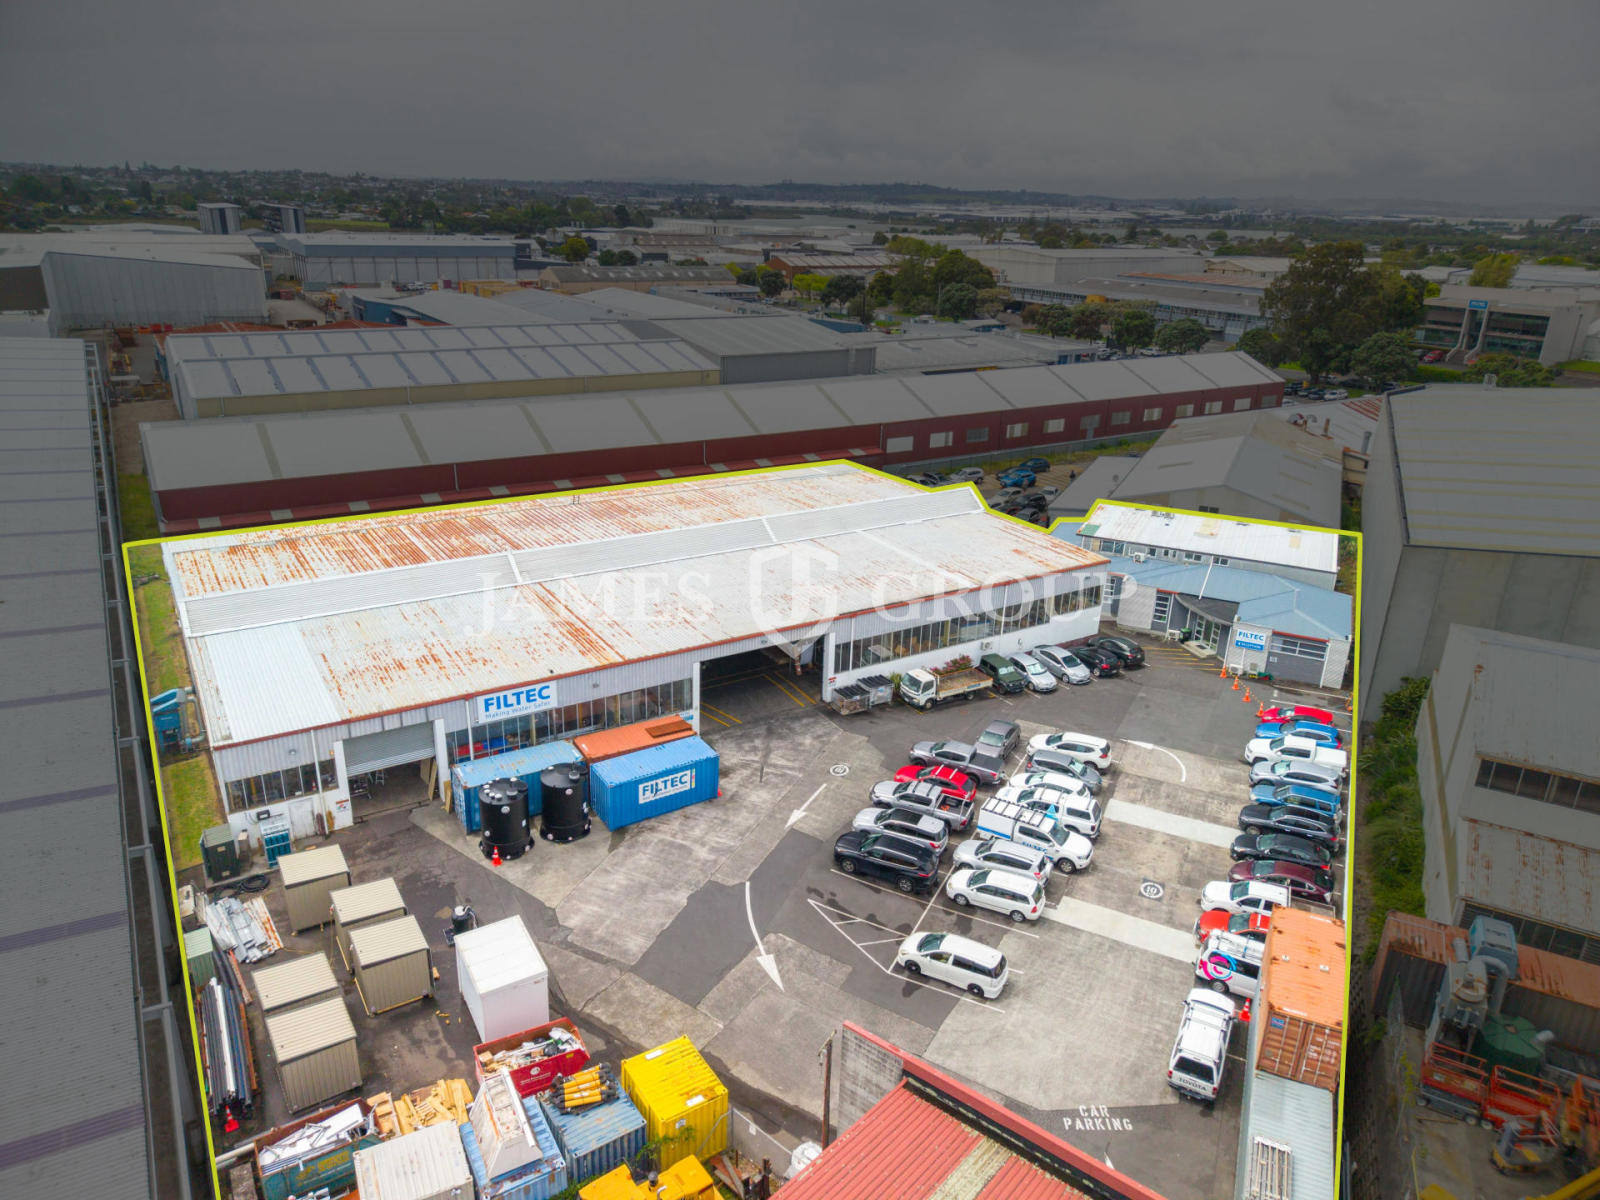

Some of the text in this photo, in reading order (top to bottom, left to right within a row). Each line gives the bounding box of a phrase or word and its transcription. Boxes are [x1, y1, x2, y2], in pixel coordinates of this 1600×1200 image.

[1238, 631, 1264, 641] FILTEC
[484, 685, 550, 712] FILTEC
[642, 773, 688, 797] FILTEC
[1179, 1077, 1207, 1091] TOYOTA
[1079, 1104, 1110, 1117] CAR
[1063, 1117, 1133, 1131] PARKING
